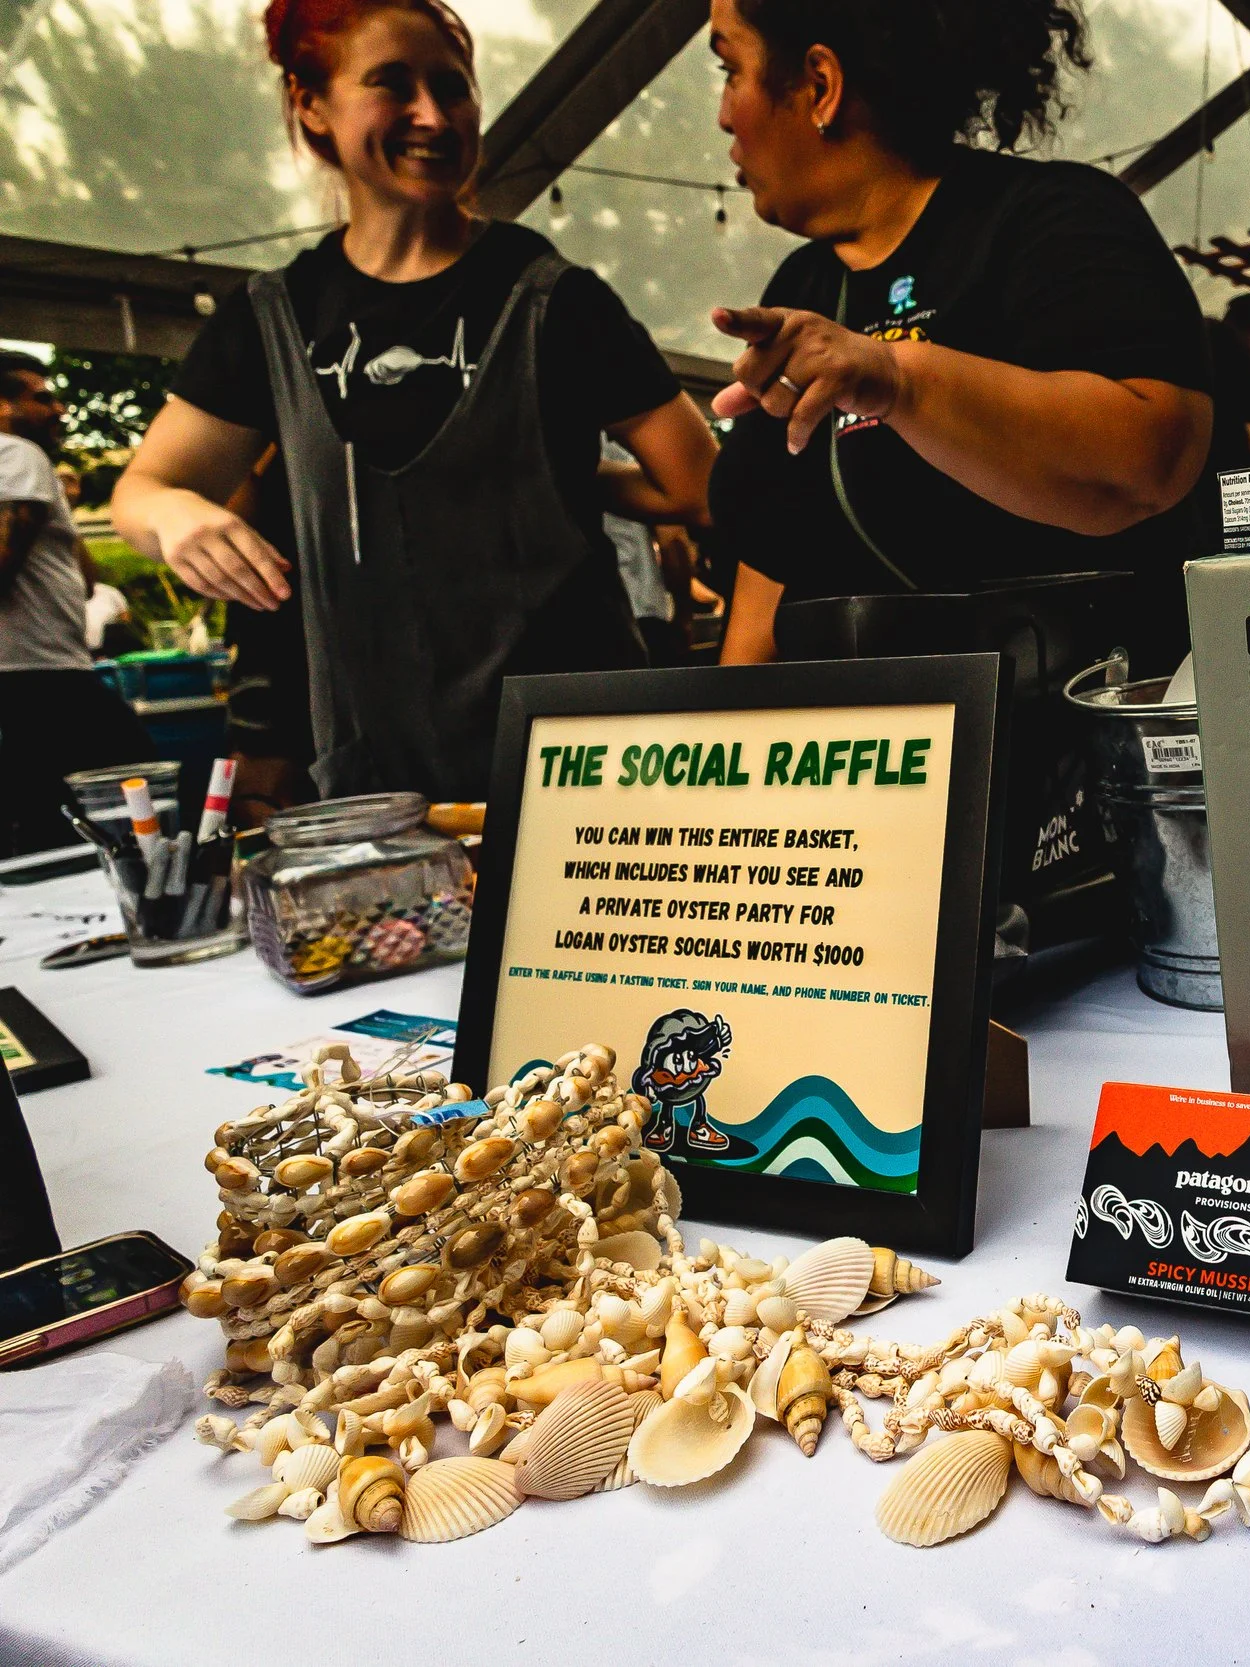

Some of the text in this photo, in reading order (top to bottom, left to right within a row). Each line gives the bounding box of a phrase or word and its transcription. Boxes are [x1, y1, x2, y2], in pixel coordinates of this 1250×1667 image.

[539, 738, 931, 787] THE SOCIAL RAFFLE
[575, 826, 857, 851] YOU CAN WIN THIS ENTIRE BASKET,
[1038, 815, 1067, 848] MON
[1032, 830, 1080, 871] BLANC
[564, 860, 863, 887] WHICH INCLUDES WHAT YOU SEE AND
[579, 896, 834, 925] A PRIVATE OYSTER PARTY FOR
[554, 929, 863, 966] LOGAN OYSTER SOCIALS WORTH $1000
[508, 966, 929, 1006] ENTER THE RAFFLE USING A TASTING TICKET. SIGN YOUR NAME, AND PHONE NUMBER ON TICKET.
[1169, 1094, 1187, 1103] We're
[1196, 1097, 1225, 1106] business
[1147, 1261, 1196, 1281] SPICY
[1128, 1275, 1136, 1284] IN
[1137, 1277, 1183, 1291] EXTRA-VIRGIN
[1184, 1284, 1205, 1295] OLIVE
[1205, 1288, 1217, 1297] OIL
[1222, 1290, 1235, 1299] NET
[1236, 1293, 1247, 1301] WT
